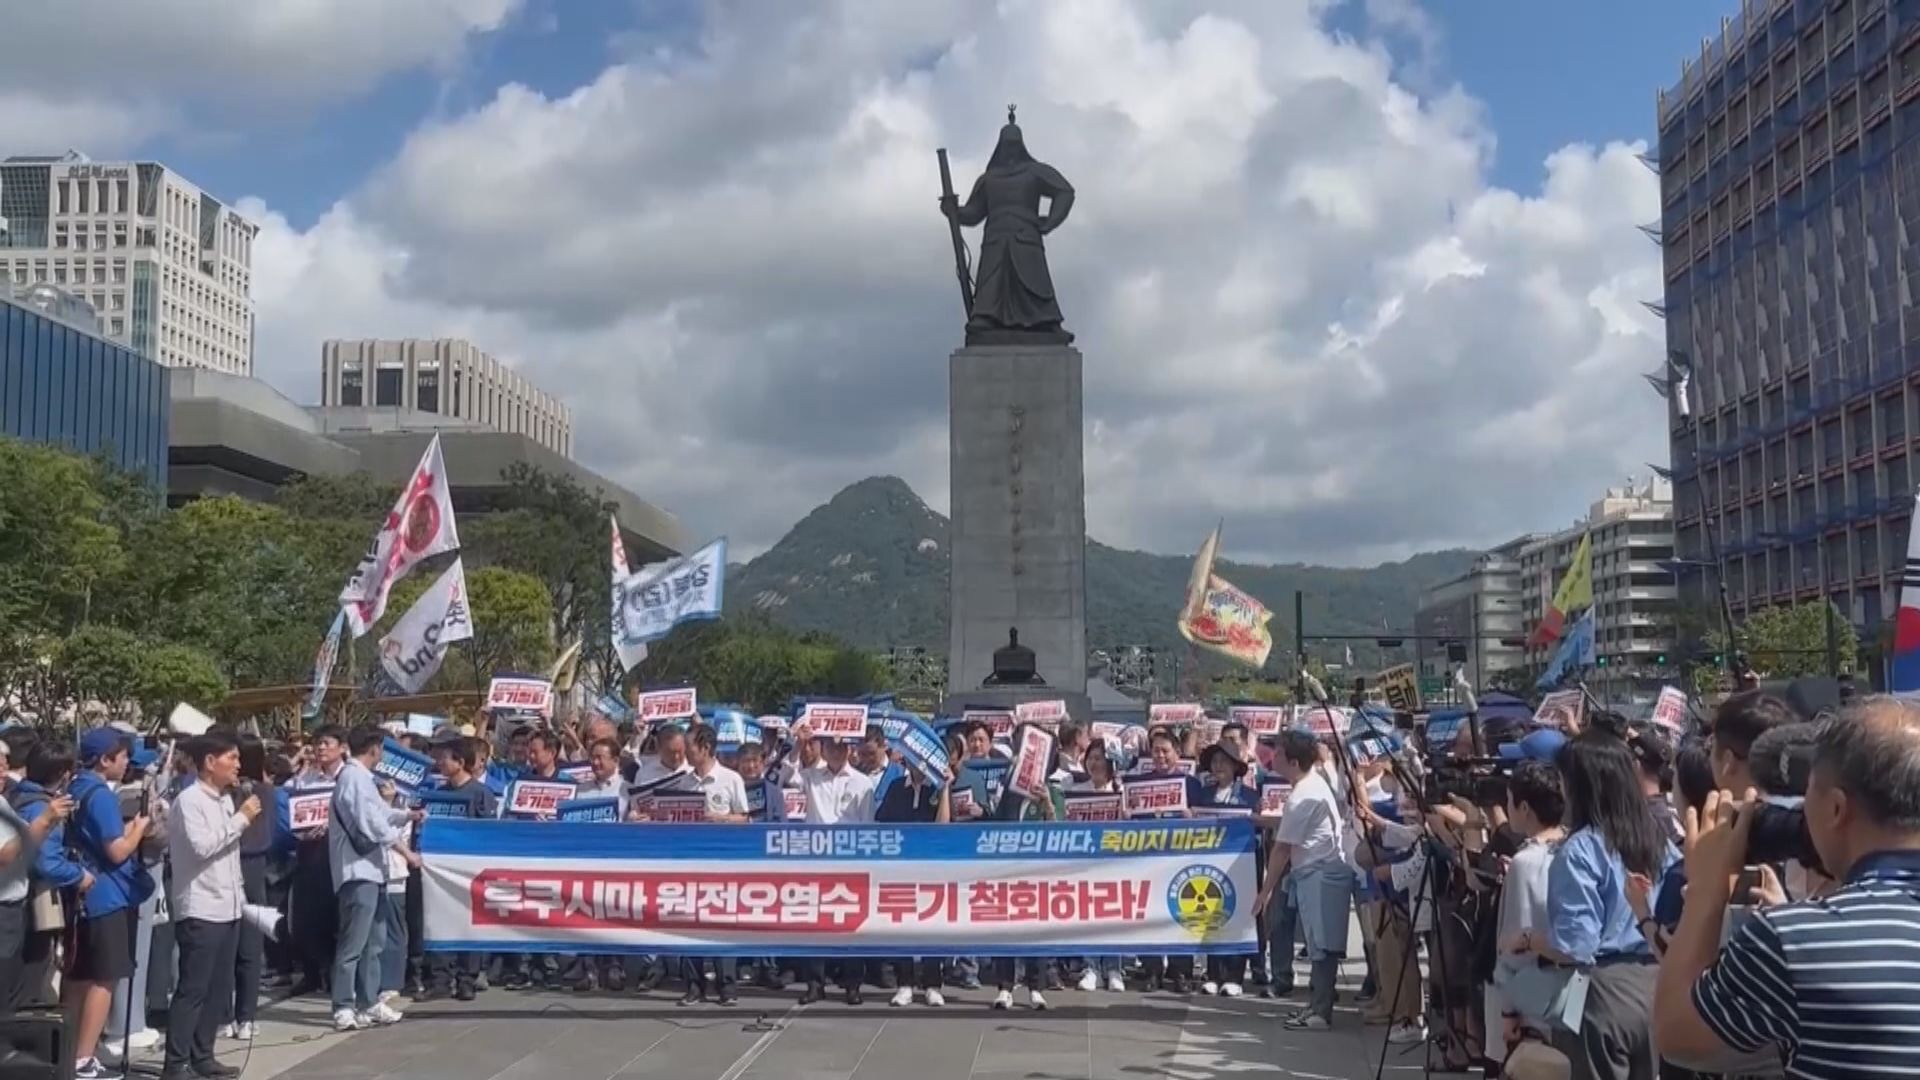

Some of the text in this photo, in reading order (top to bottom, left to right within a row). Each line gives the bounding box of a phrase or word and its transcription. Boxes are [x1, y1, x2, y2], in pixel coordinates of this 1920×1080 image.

[1128, 789, 1183, 809] 투기철회
[765, 830, 904, 857] 더불어민주당
[976, 827, 1226, 855] 생명의 바다, 죽이지 마라!
[483, 878, 1151, 924] 후쿠시마 원전오염수 투기 철회하라!
